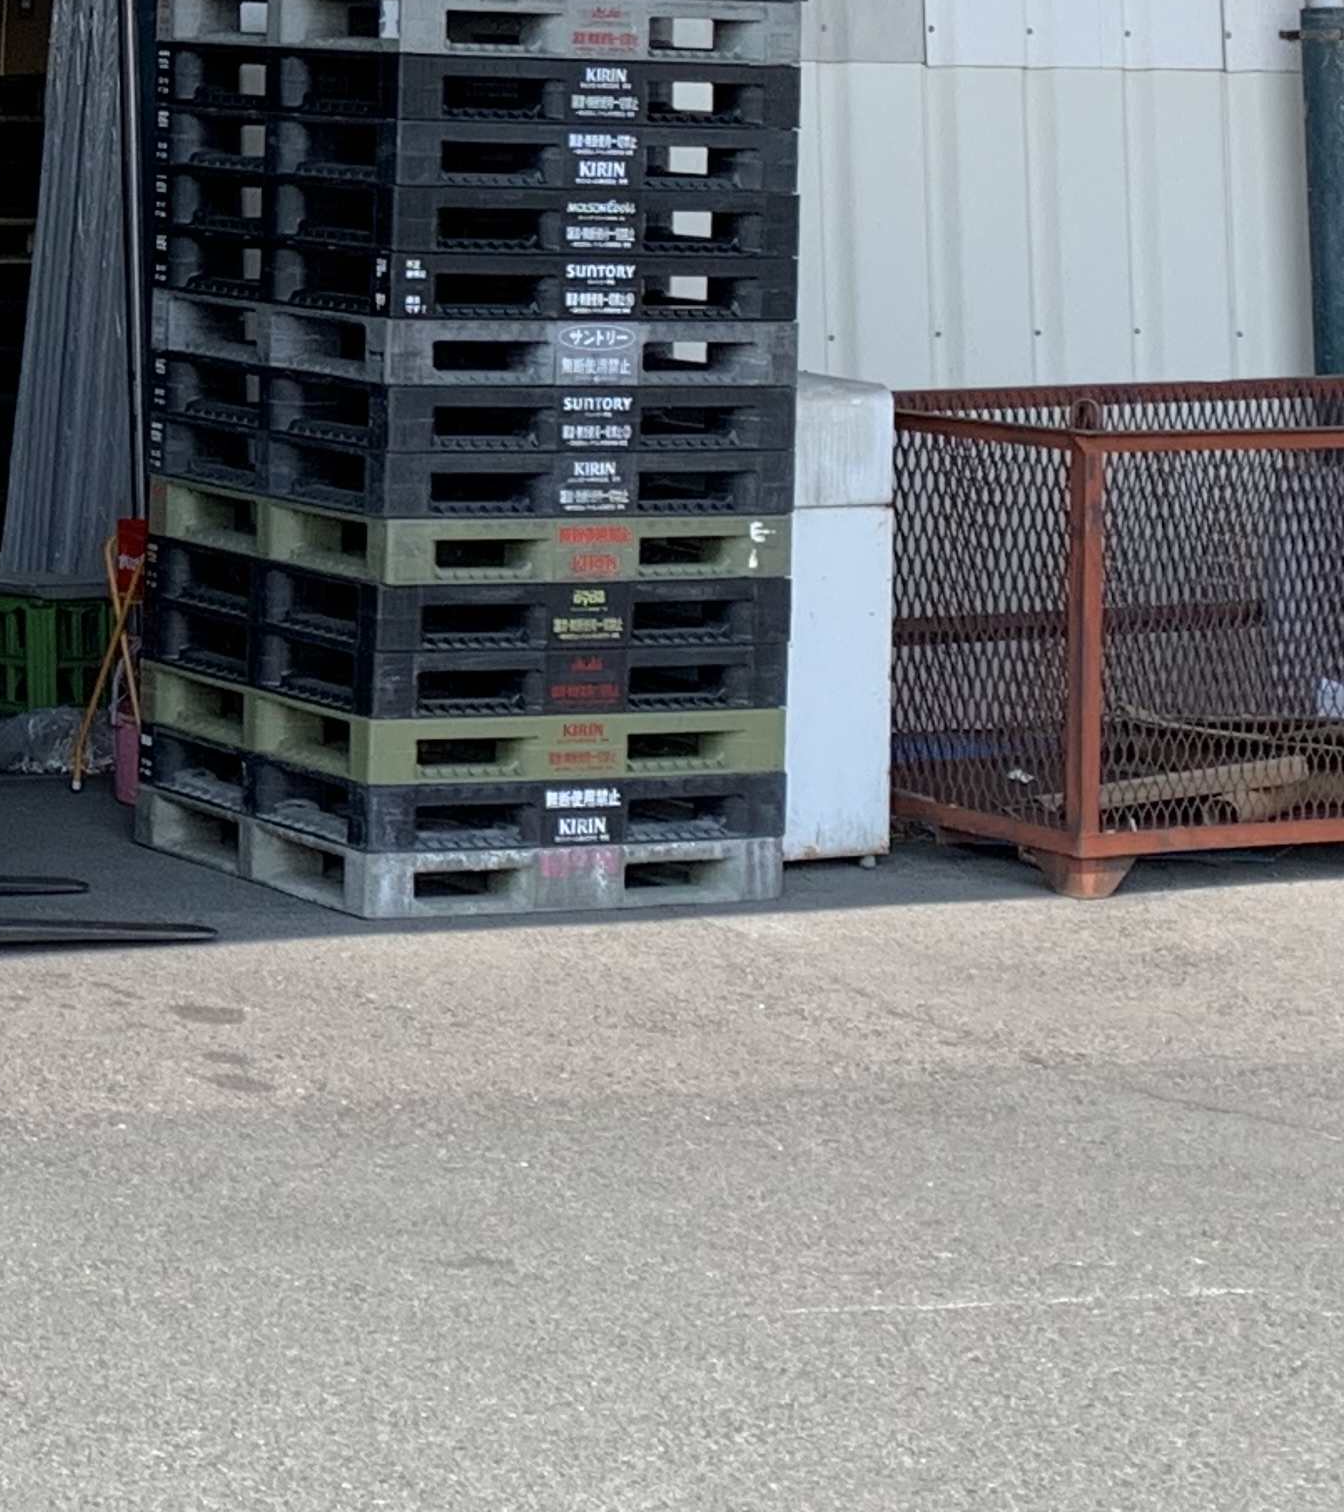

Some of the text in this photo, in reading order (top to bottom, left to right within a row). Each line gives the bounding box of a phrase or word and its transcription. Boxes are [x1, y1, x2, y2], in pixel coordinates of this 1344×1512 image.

[585, 67, 628, 83] KIRIN
[578, 160, 626, 178] KIRIN
[564, 263, 637, 279] SUNTORY
[568, 328, 629, 346] サントリー
[562, 396, 633, 411] SUNTORY
[573, 460, 617, 476] KIRIN
[562, 722, 605, 737] KIRIN
[558, 817, 608, 835] KIRIN
